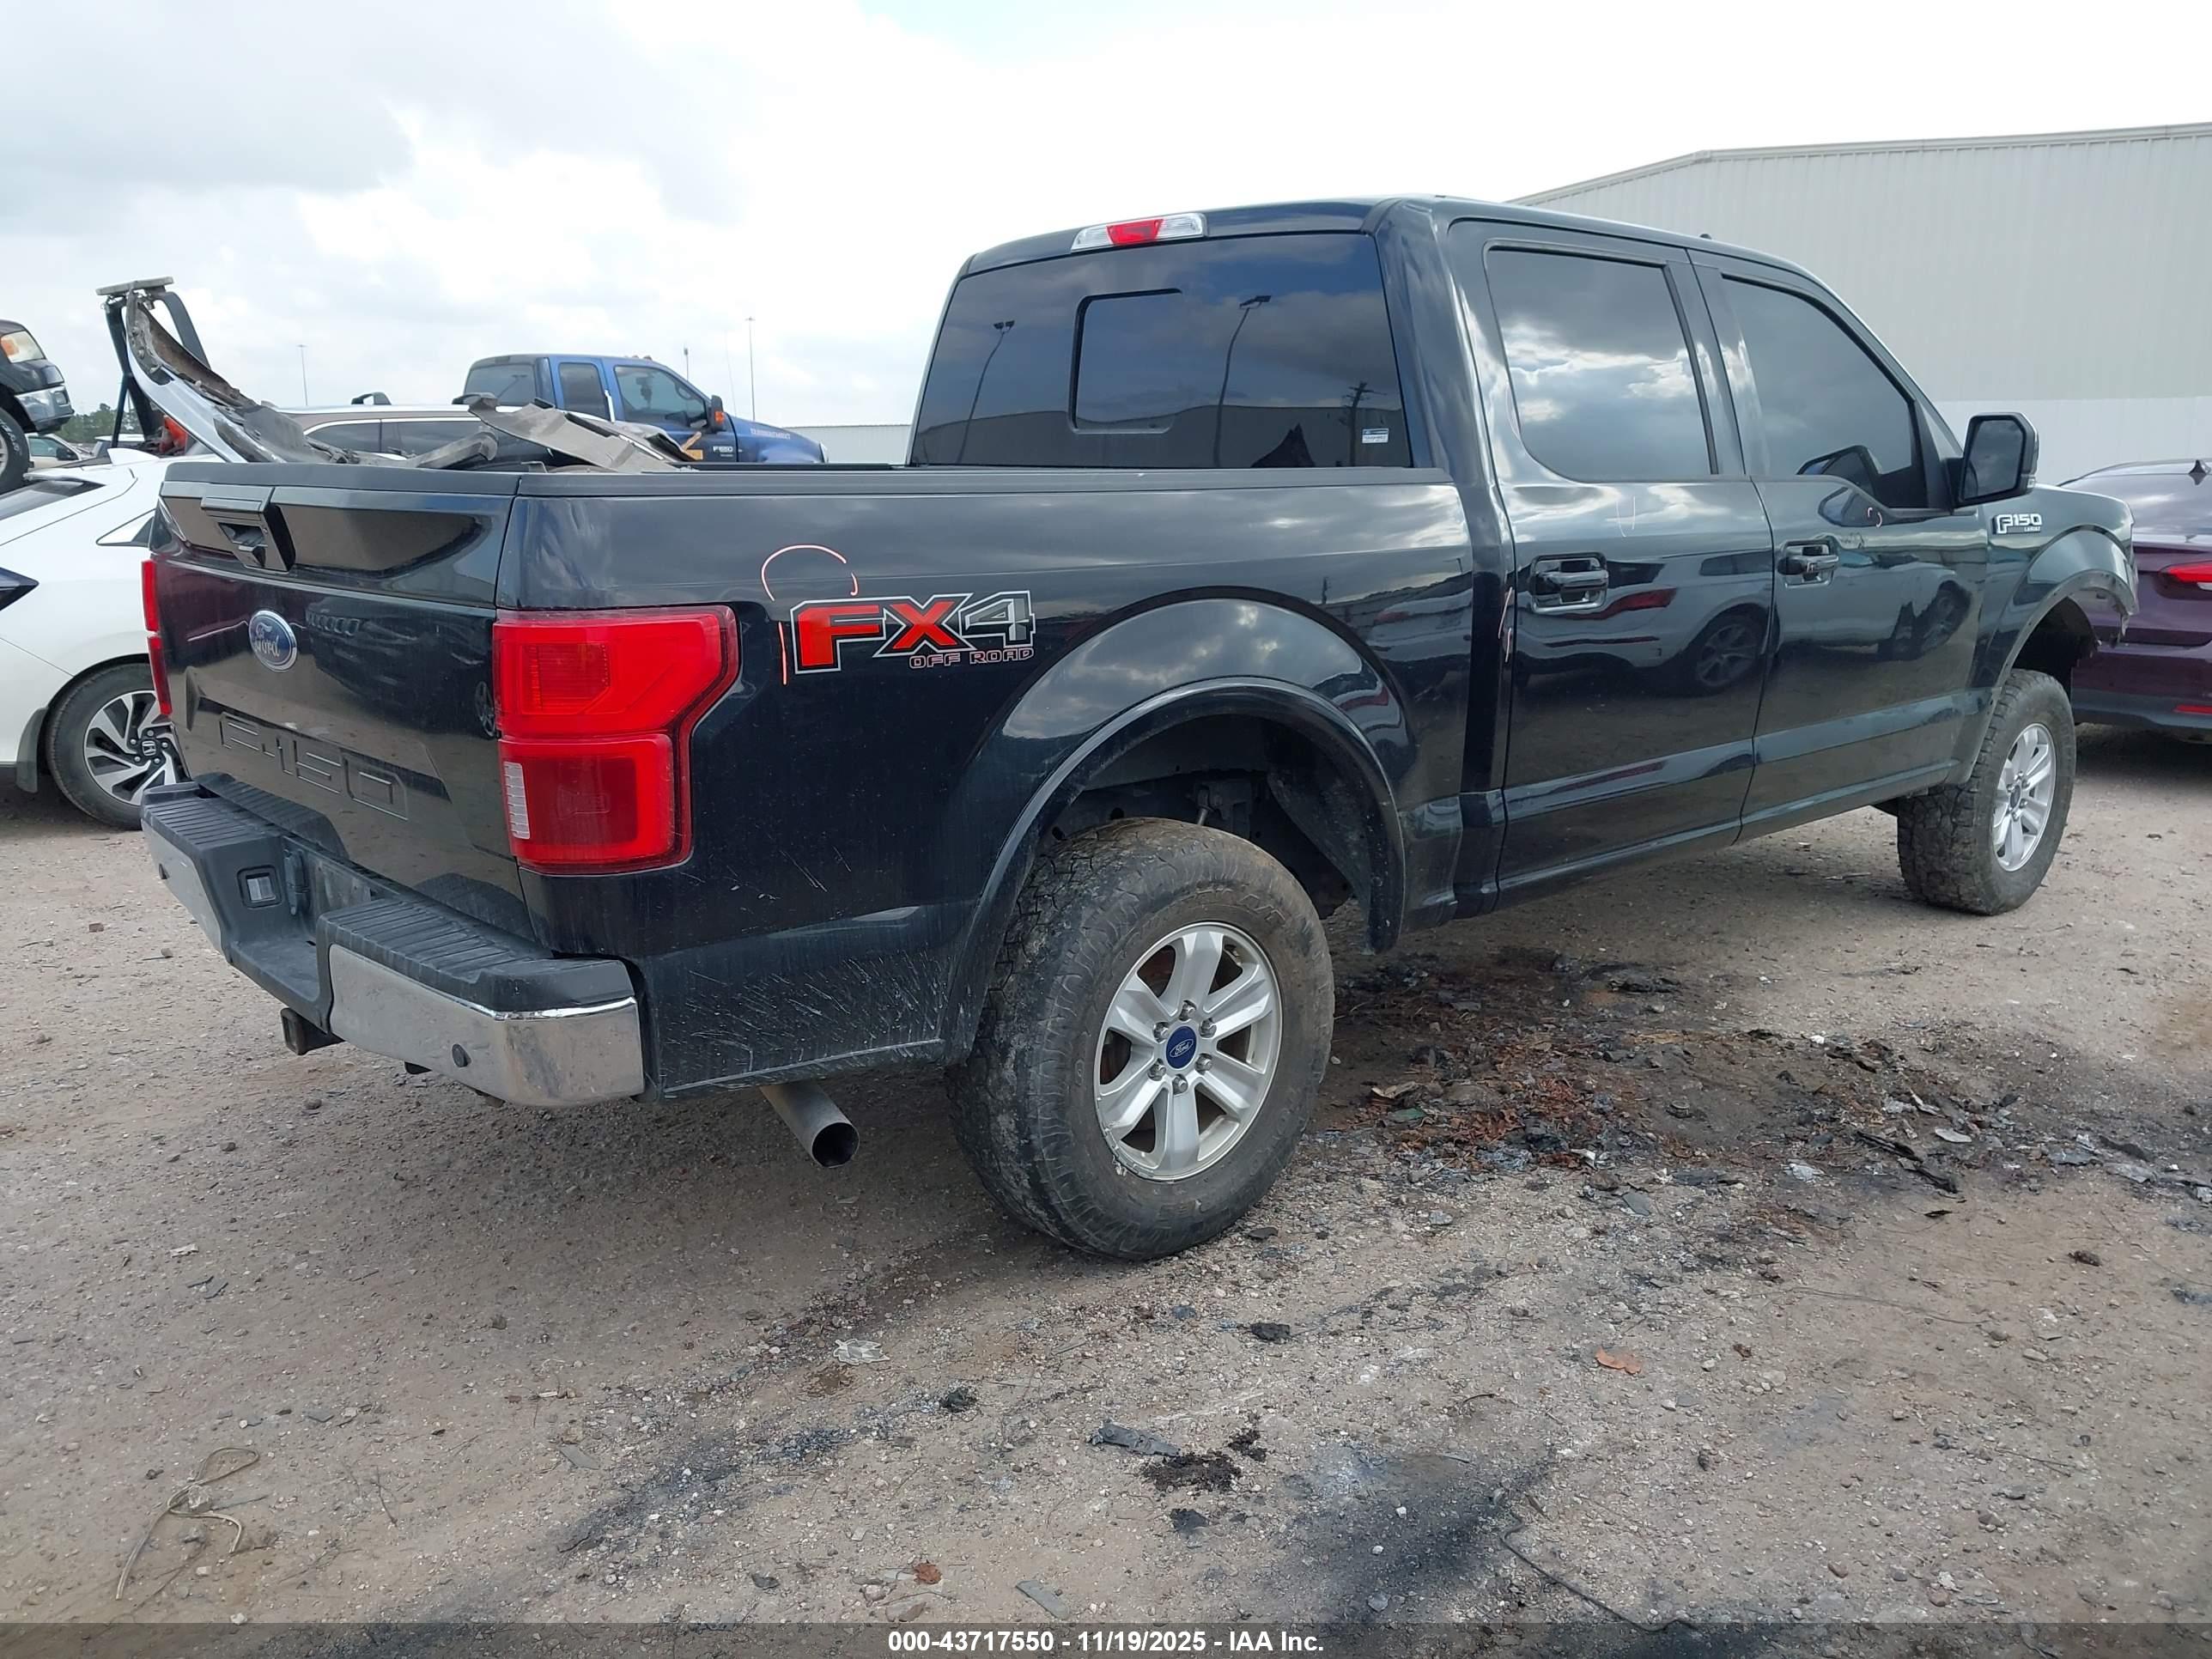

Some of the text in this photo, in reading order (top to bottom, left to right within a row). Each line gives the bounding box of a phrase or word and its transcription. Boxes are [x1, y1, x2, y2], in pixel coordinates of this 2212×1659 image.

[1996, 514, 2042, 534] F150
[790, 591, 1036, 674] FX4
[909, 647, 1034, 669] OFF ROAD
